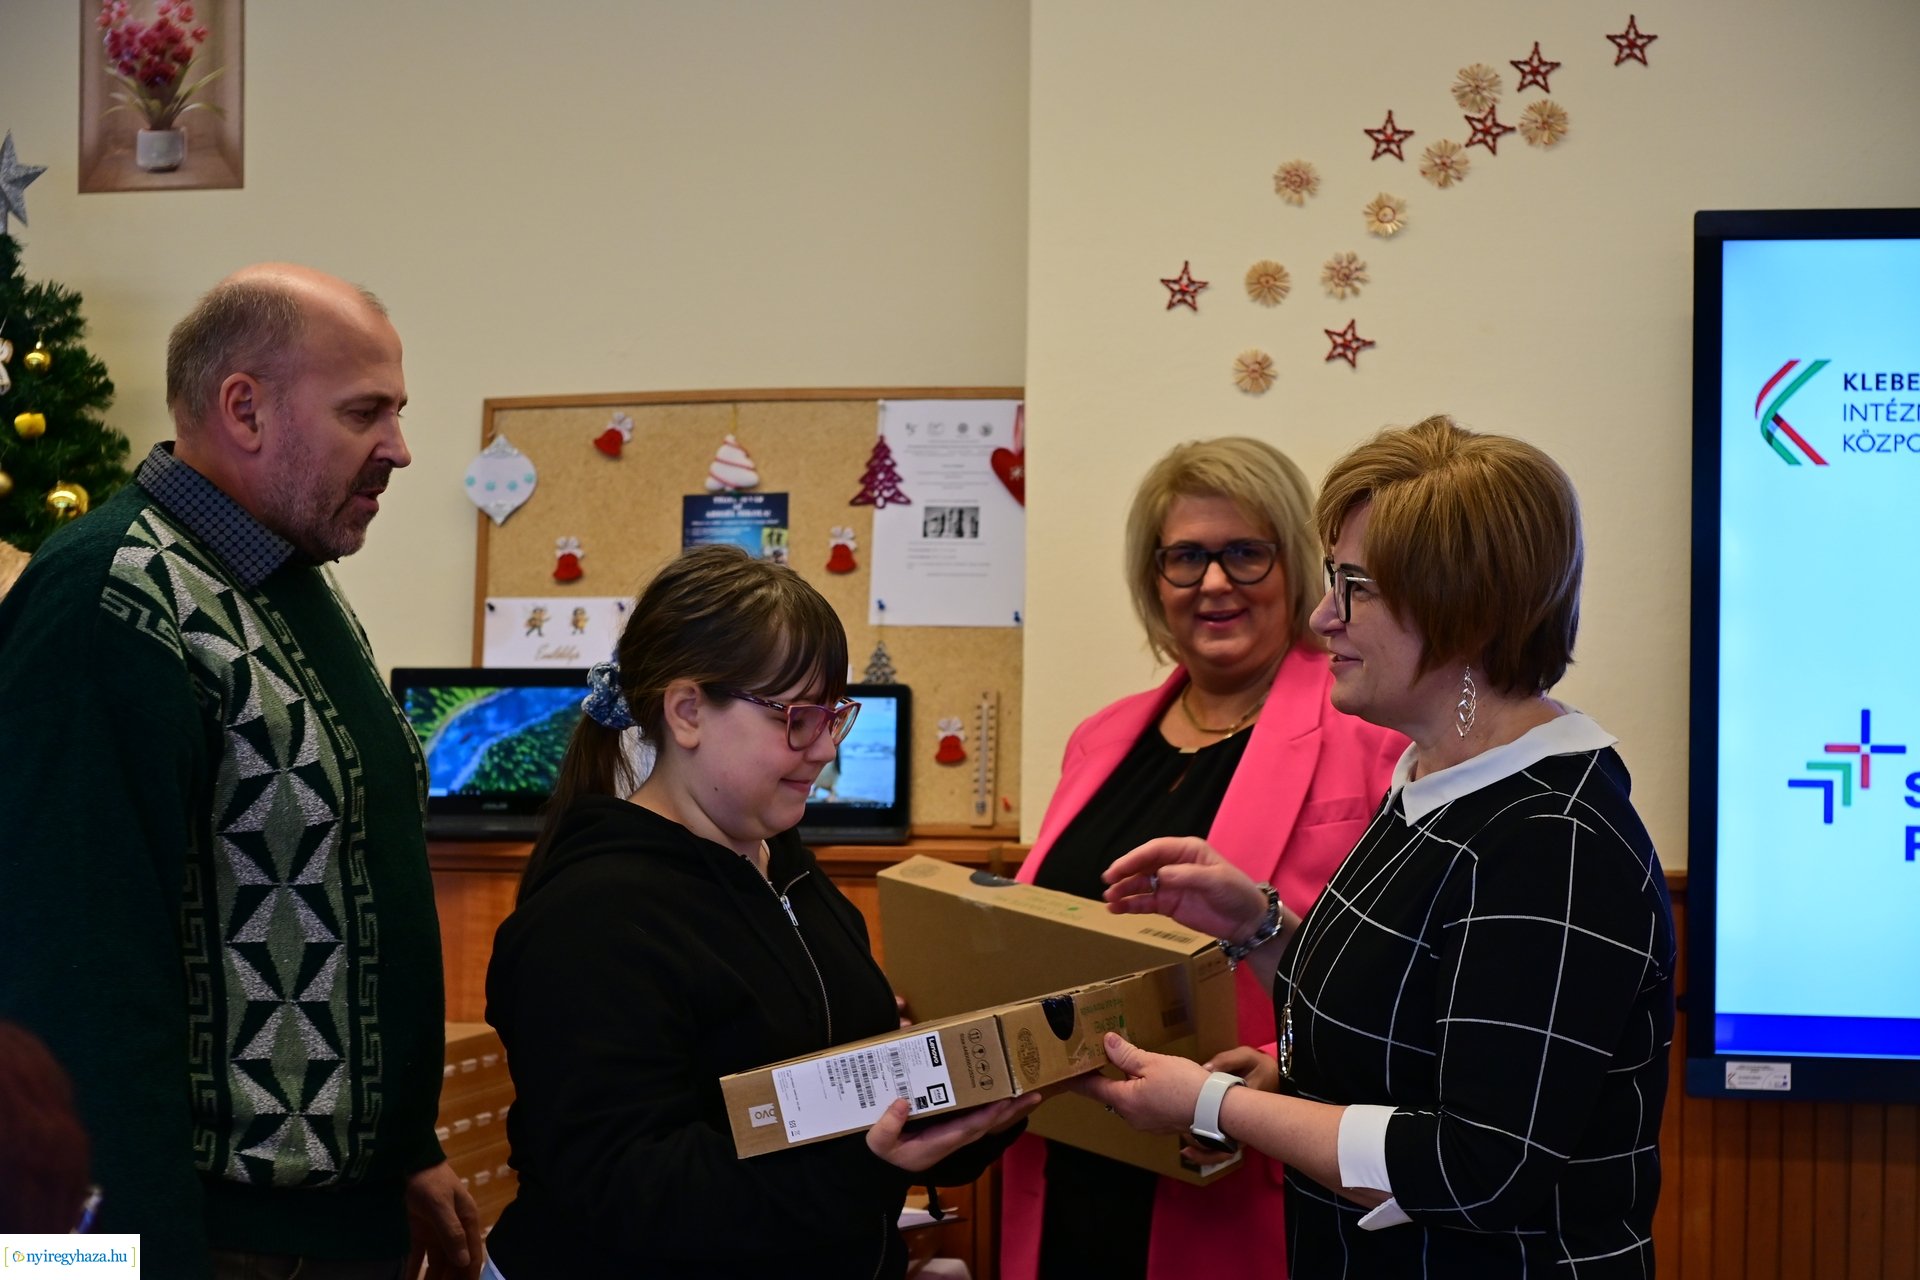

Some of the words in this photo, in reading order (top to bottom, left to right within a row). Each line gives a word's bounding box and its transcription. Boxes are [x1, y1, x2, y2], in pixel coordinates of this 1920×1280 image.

[1844, 373, 1920, 391] KLEBE
[1843, 398, 1920, 422] INTÉZ
[927, 1037, 940, 1064] Lenovo
